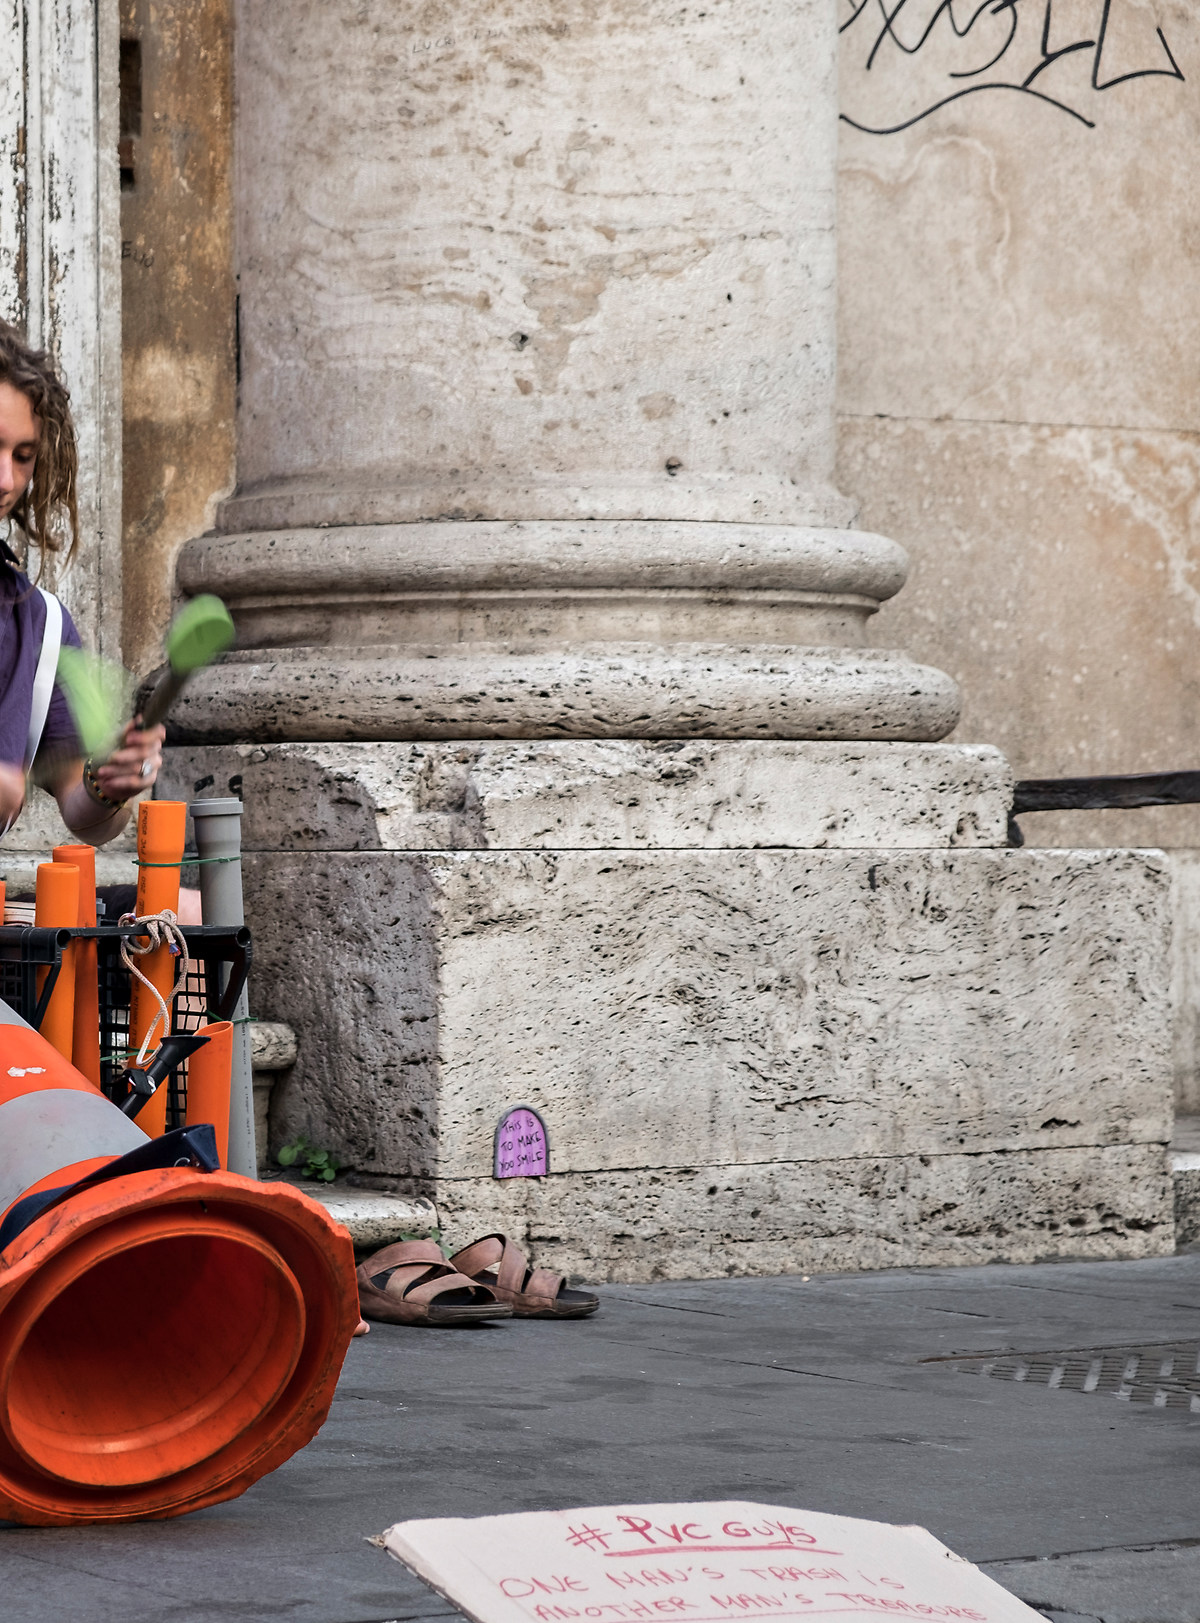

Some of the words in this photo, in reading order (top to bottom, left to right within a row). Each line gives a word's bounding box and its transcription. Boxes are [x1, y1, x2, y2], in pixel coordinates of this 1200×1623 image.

[502, 1120, 522, 1133] THIS
[526, 1117, 535, 1128] IS
[501, 1141, 514, 1151] TO
[517, 1131, 542, 1148] MAKE
[516, 1150, 544, 1167] SMILE
[499, 1575, 589, 1598] ONE
[605, 1566, 725, 1590] MAN'S
[740, 1566, 849, 1582] TRASH
[533, 1596, 699, 1621] ANOTHER
[710, 1592, 814, 1610] MAN'S
[825, 1593, 988, 1621] TREASURE
